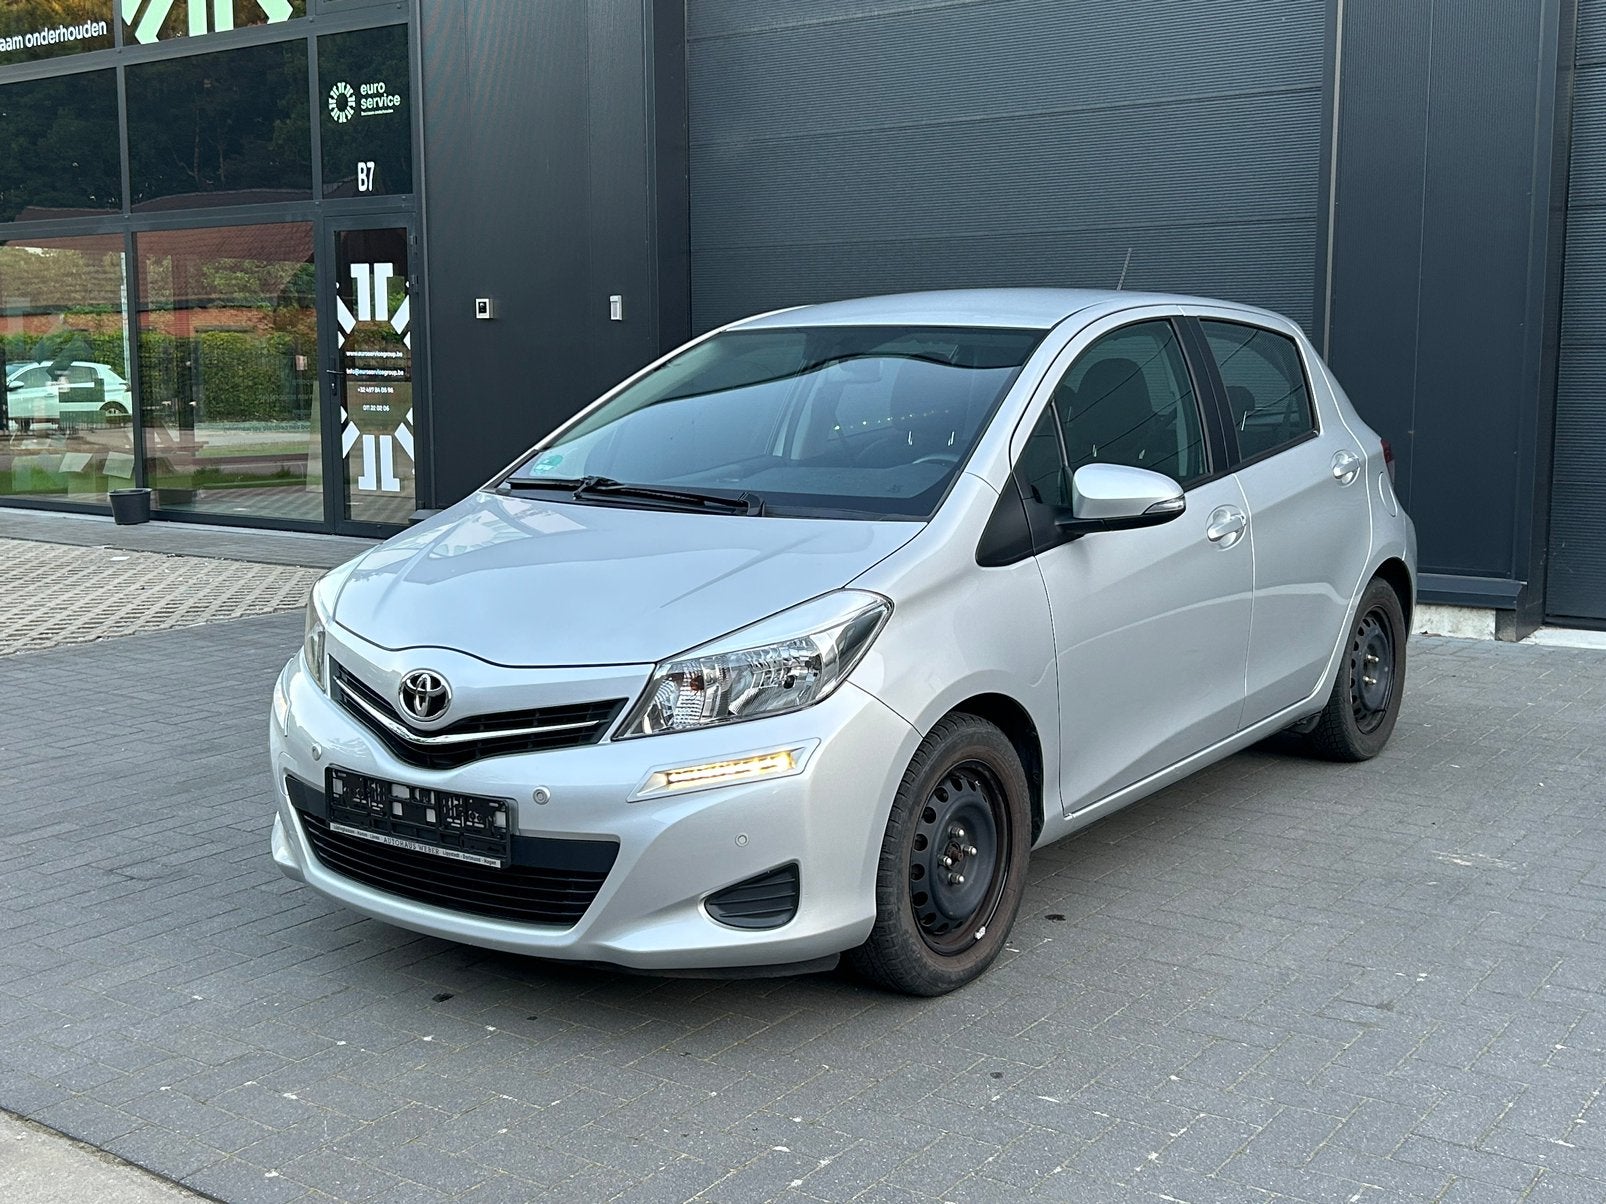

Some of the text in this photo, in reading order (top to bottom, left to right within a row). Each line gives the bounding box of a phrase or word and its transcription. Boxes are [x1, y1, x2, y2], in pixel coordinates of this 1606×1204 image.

[25, 20, 107, 48] onderhouden
[360, 82, 385, 95] euro
[361, 93, 401, 109] service
[357, 161, 375, 192] B7
[384, 837, 416, 849] AUTOHAUS
[418, 845, 440, 855] WEBER
